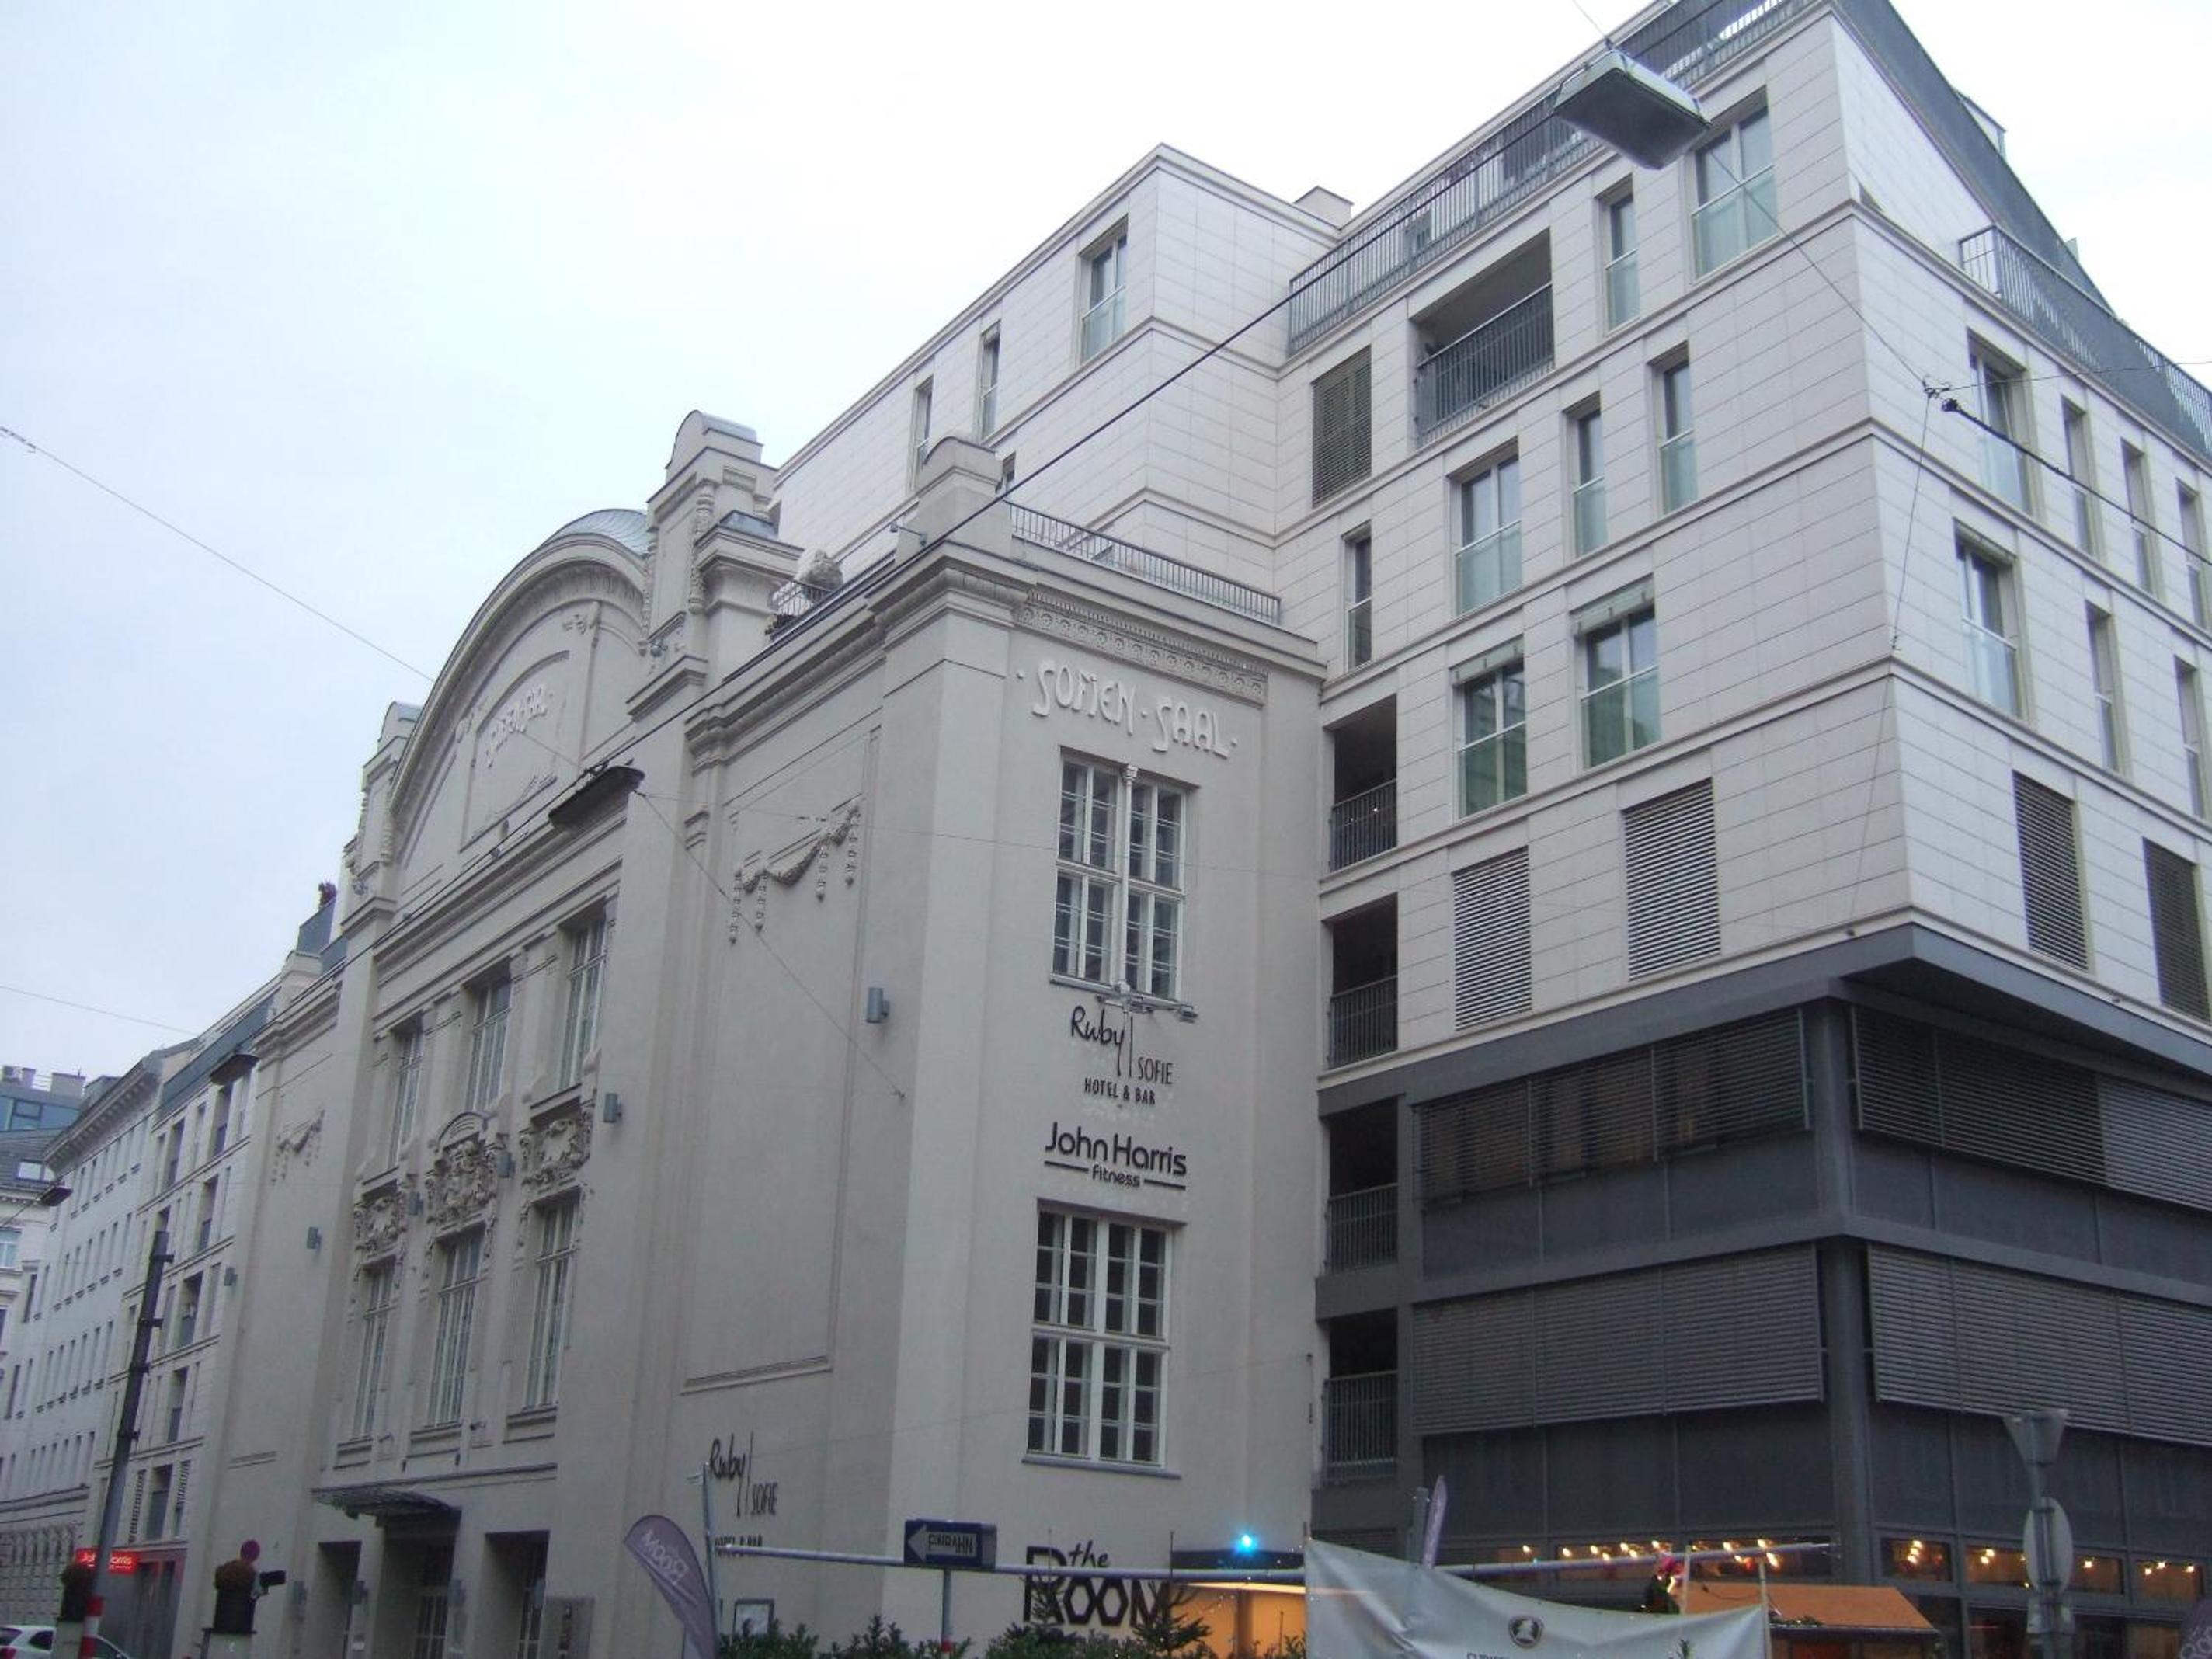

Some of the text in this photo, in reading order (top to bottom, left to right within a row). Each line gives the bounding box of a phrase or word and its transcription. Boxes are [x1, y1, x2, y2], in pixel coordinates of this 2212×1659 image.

[1152, 697, 1230, 758] SAAL
[1070, 1005, 1174, 1085] Ruby SOFIE
[1084, 1077, 1156, 1105] HOTEL & BAR
[1092, 1163, 1140, 1188] fitness
[710, 1433, 777, 1518] Ruby SOFIE
[1069, 1539, 1110, 1567] the
[1024, 1546, 1170, 1627] ROOM
